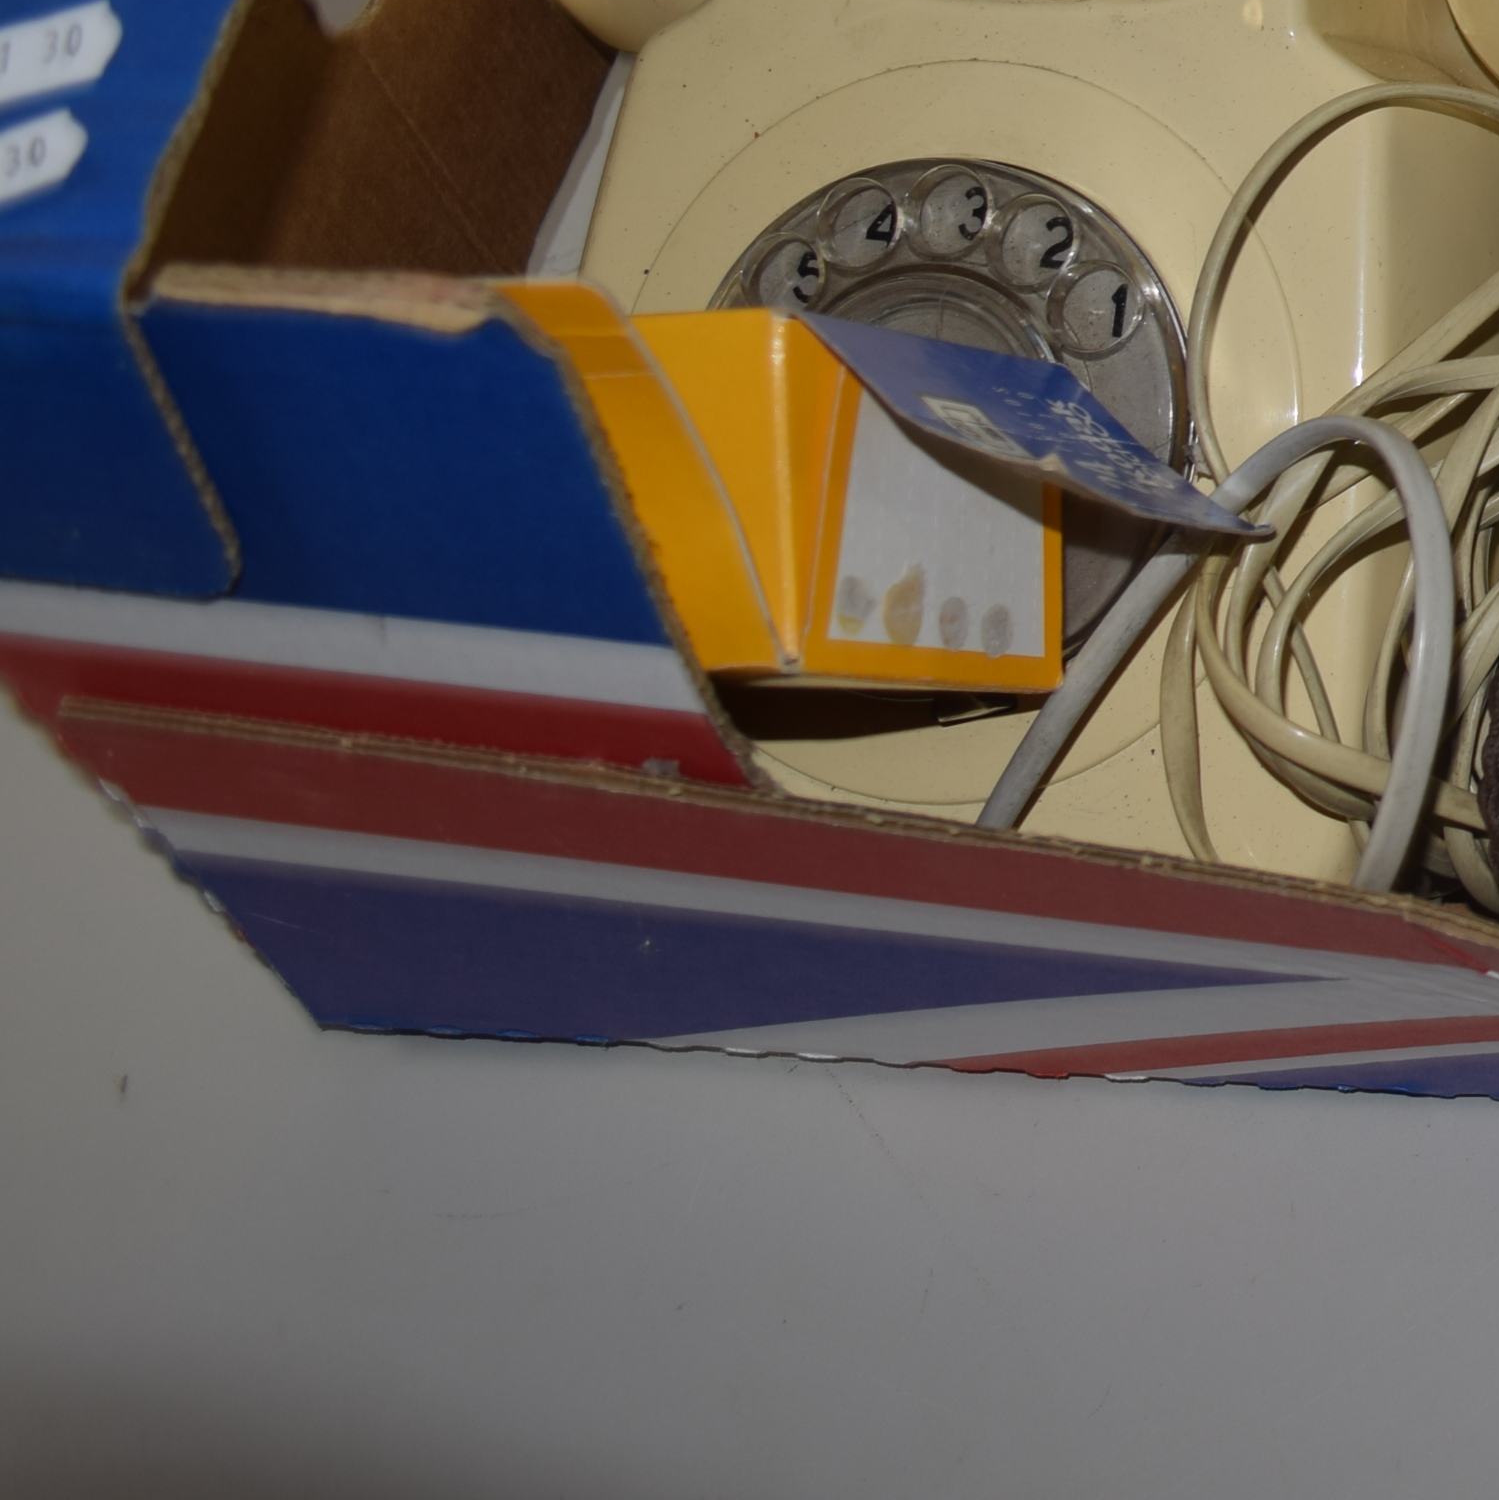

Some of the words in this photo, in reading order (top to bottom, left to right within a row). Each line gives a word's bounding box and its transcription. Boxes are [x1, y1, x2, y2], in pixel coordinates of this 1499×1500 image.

[865, 202, 896, 248] 4
[958, 186, 988, 241] 3
[1040, 217, 1072, 269] 2
[793, 251, 820, 304] 5
[1111, 283, 1128, 338] 1
